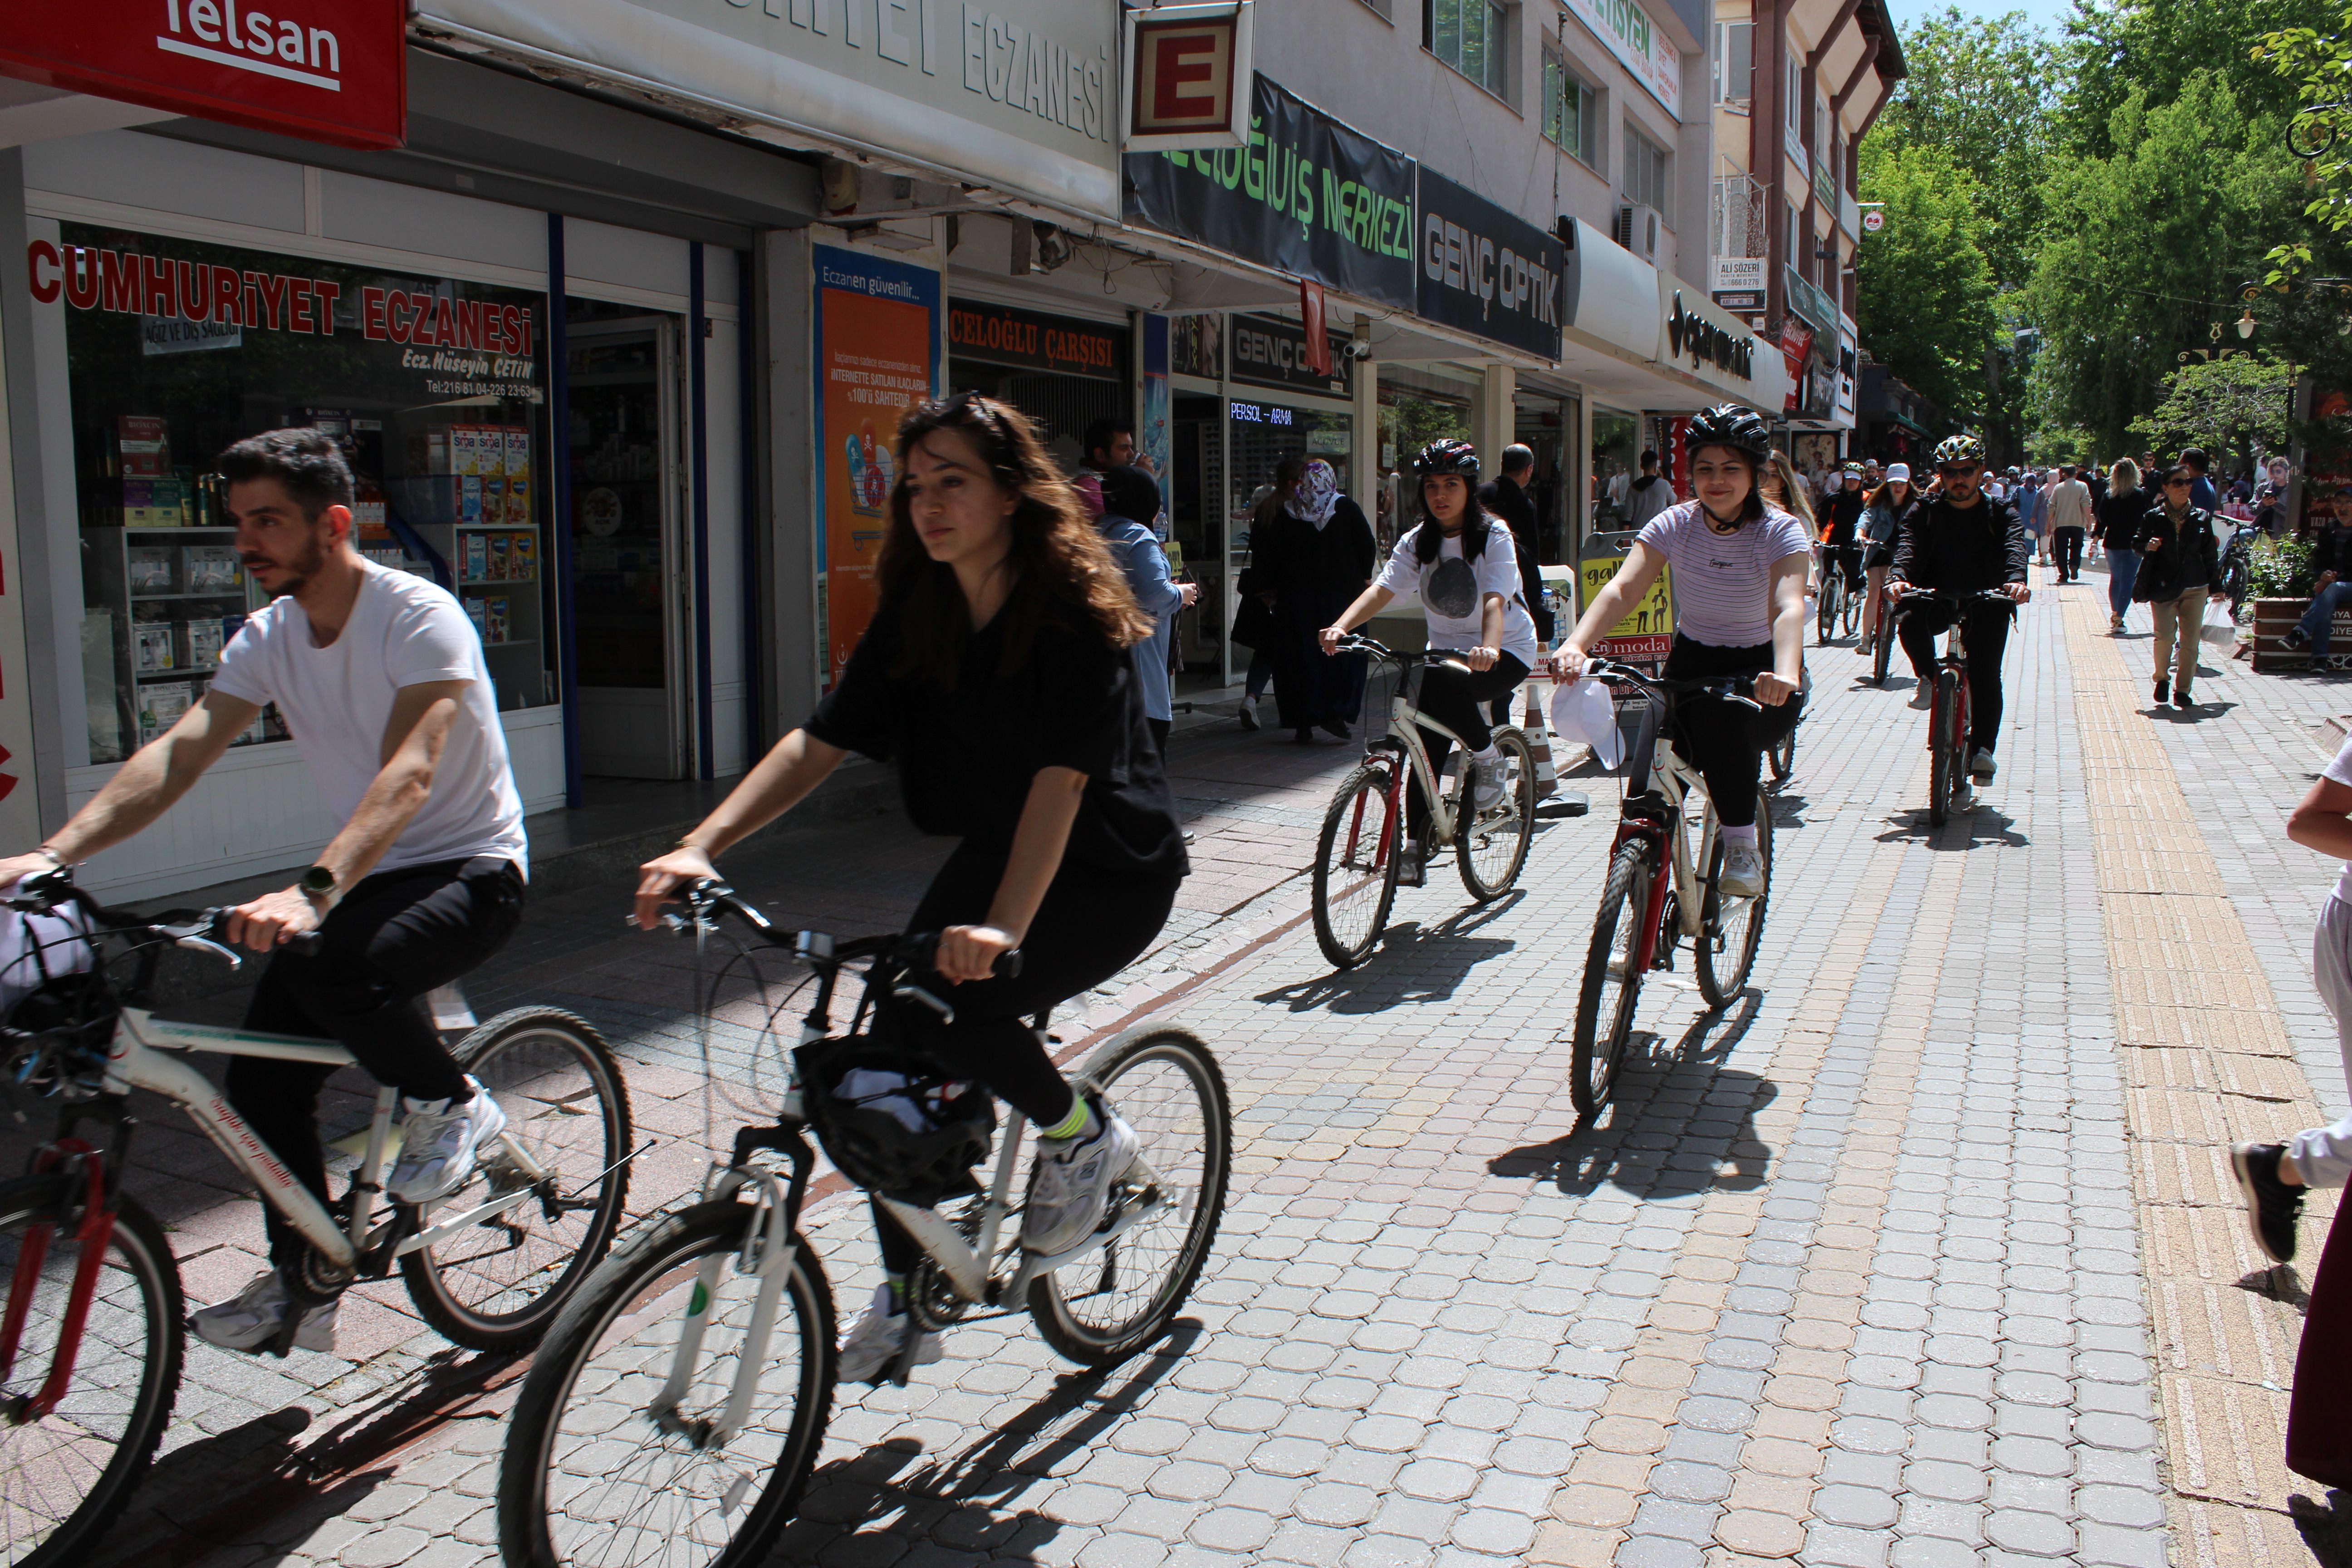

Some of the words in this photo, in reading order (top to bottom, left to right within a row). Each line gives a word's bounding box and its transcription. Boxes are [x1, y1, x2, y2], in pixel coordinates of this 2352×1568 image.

[963, 3, 1108, 143] ECZANESİ
[1154, 34, 1215, 119] E
[1322, 167, 1413, 261] MERKEZİ
[823, 265, 866, 289] Eczanen
[1425, 213, 1495, 322] GENÇ
[1500, 248, 1558, 328] OPTİK
[1721, 263, 1732, 273] ALİ
[1734, 262, 1759, 273] SÖZERİ
[146, 321, 167, 343] AĞIZ
[169, 323, 181, 341] VE
[183, 321, 200, 342] DİŞ
[950, 309, 1038, 355] CELOĞLU
[1045, 328, 1112, 372] ÇARŞISI
[402, 348, 431, 369] Ecz.
[433, 350, 489, 379] Hüseyin
[1236, 328, 1293, 379] GENÇ
[426, 380, 461, 394] Tel:216
[462, 382, 473, 394] 81
[476, 383, 505, 396] 04-226
[871, 373, 896, 387] SATILAN
[1231, 402, 1262, 422] PERSOL
[1271, 408, 1292, 426] ARMA
[1614, 637, 1667, 654] moda
